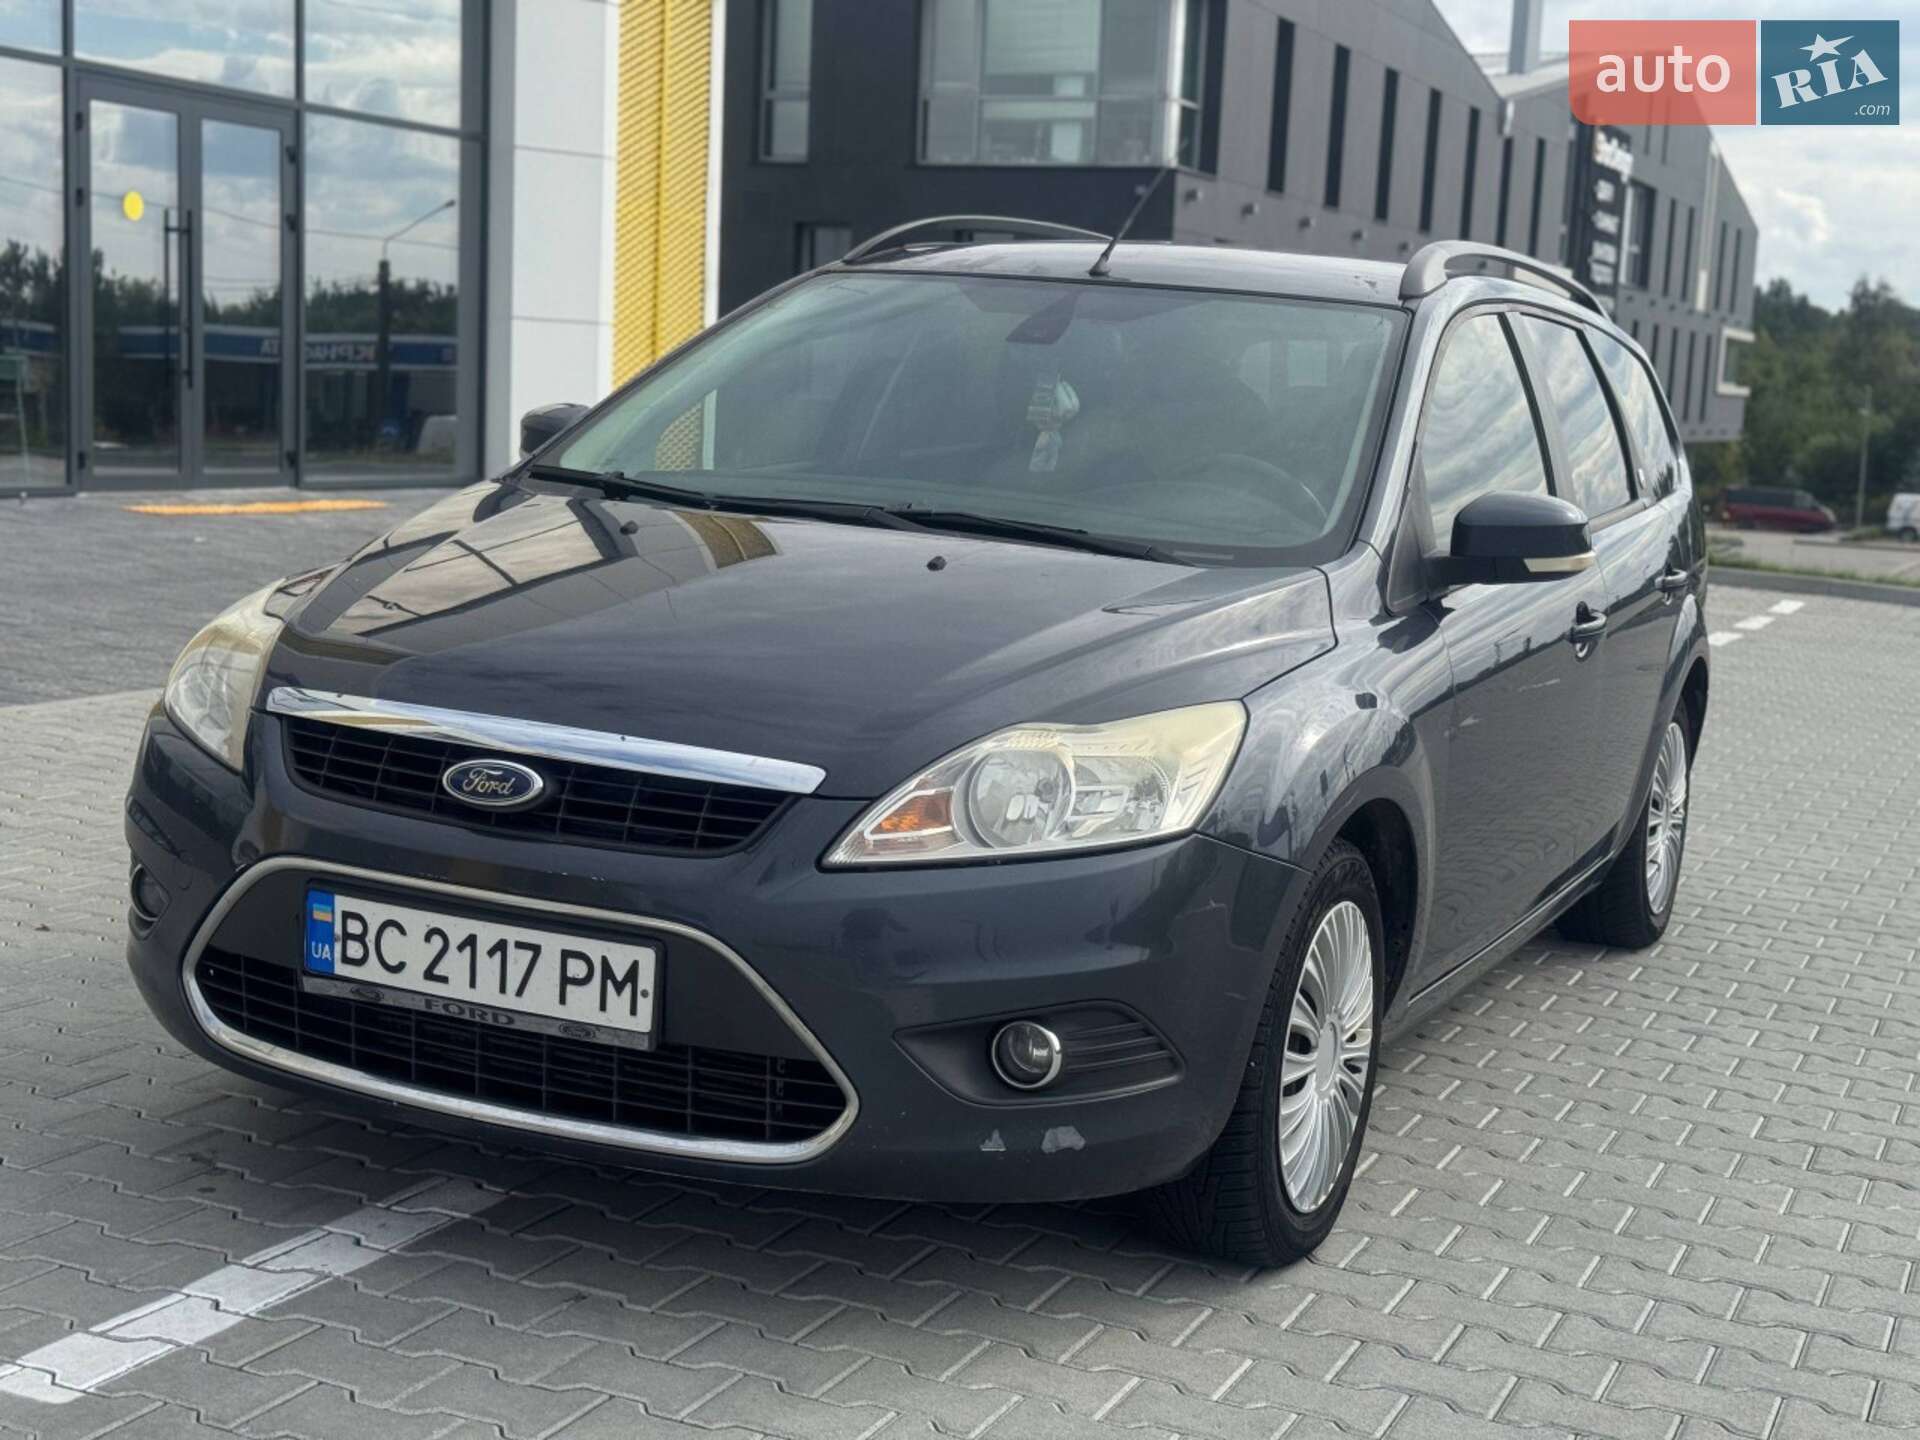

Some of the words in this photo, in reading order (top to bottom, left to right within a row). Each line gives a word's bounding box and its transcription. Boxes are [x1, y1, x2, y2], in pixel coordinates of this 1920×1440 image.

[462, 767, 516, 795] Ford
[311, 941, 332, 961] UA
[340, 910, 408, 974] BC
[423, 926, 542, 998] 2117
[559, 949, 640, 1017] PM
[424, 998, 515, 1026] FORD
